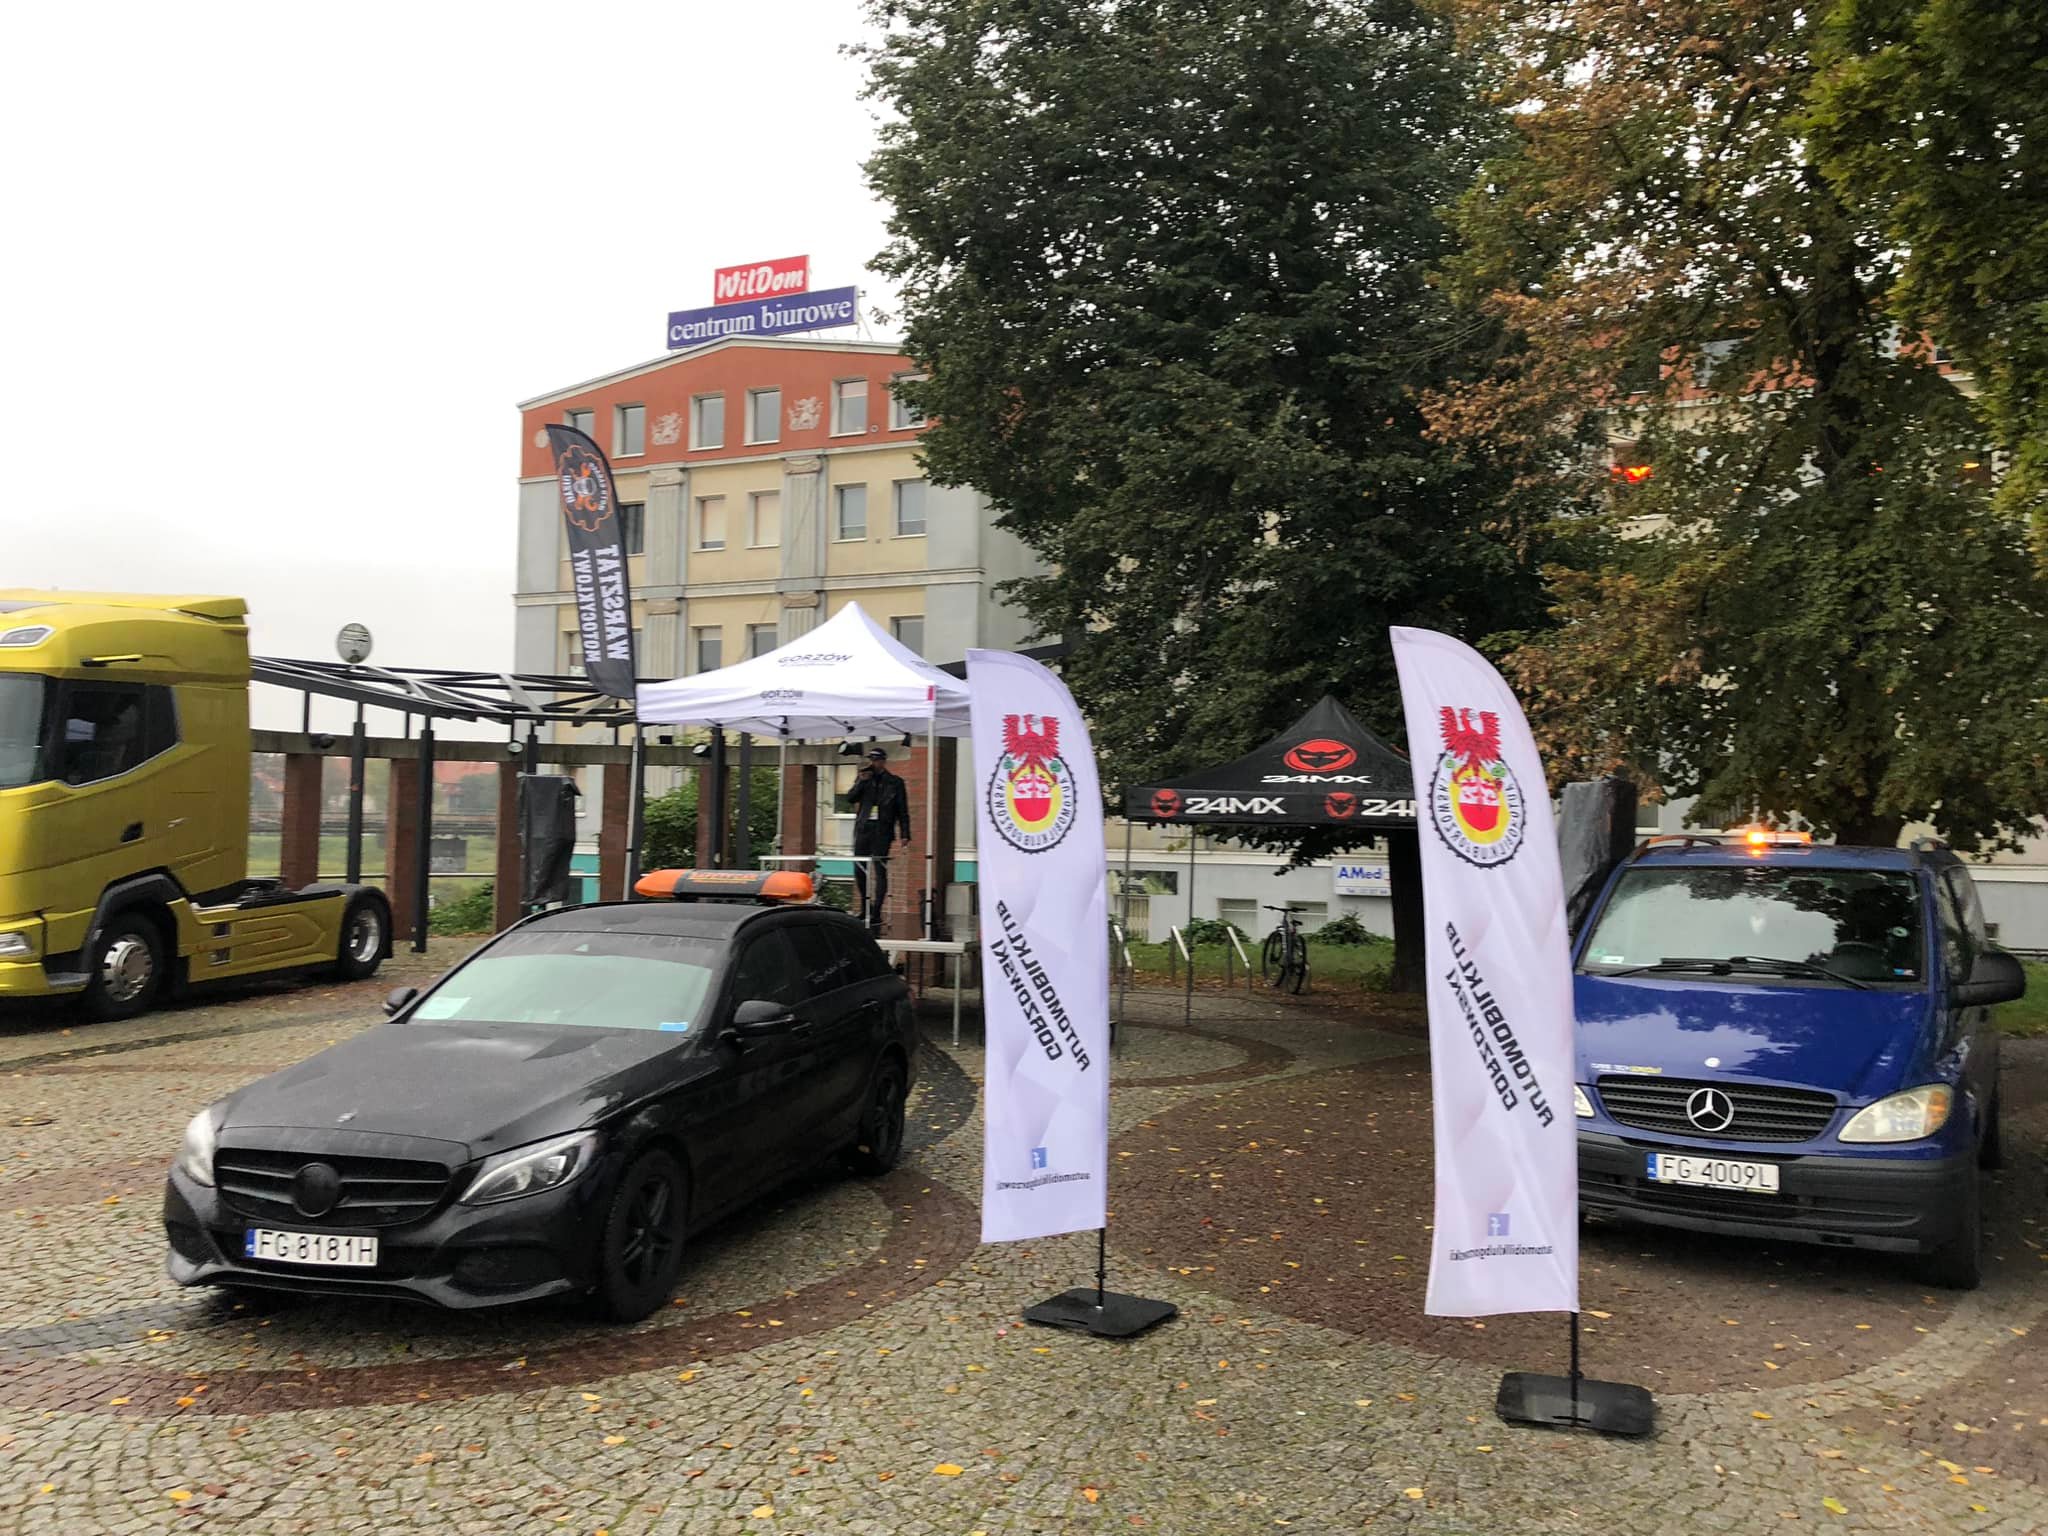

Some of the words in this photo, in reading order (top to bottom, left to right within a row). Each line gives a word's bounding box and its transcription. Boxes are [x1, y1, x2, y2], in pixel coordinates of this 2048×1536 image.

[717, 265, 804, 299] WilDom
[670, 314, 755, 341] centrum
[760, 301, 852, 329] biurowe
[1260, 775, 1372, 784] 24MX
[1185, 797, 1287, 815] 24MX
[1360, 799, 1417, 817] 24
[1663, 1156, 1691, 1179] FG
[1701, 1162, 1771, 1187] 4009L
[259, 1230, 289, 1257] FG
[296, 1235, 374, 1263] 8181H
